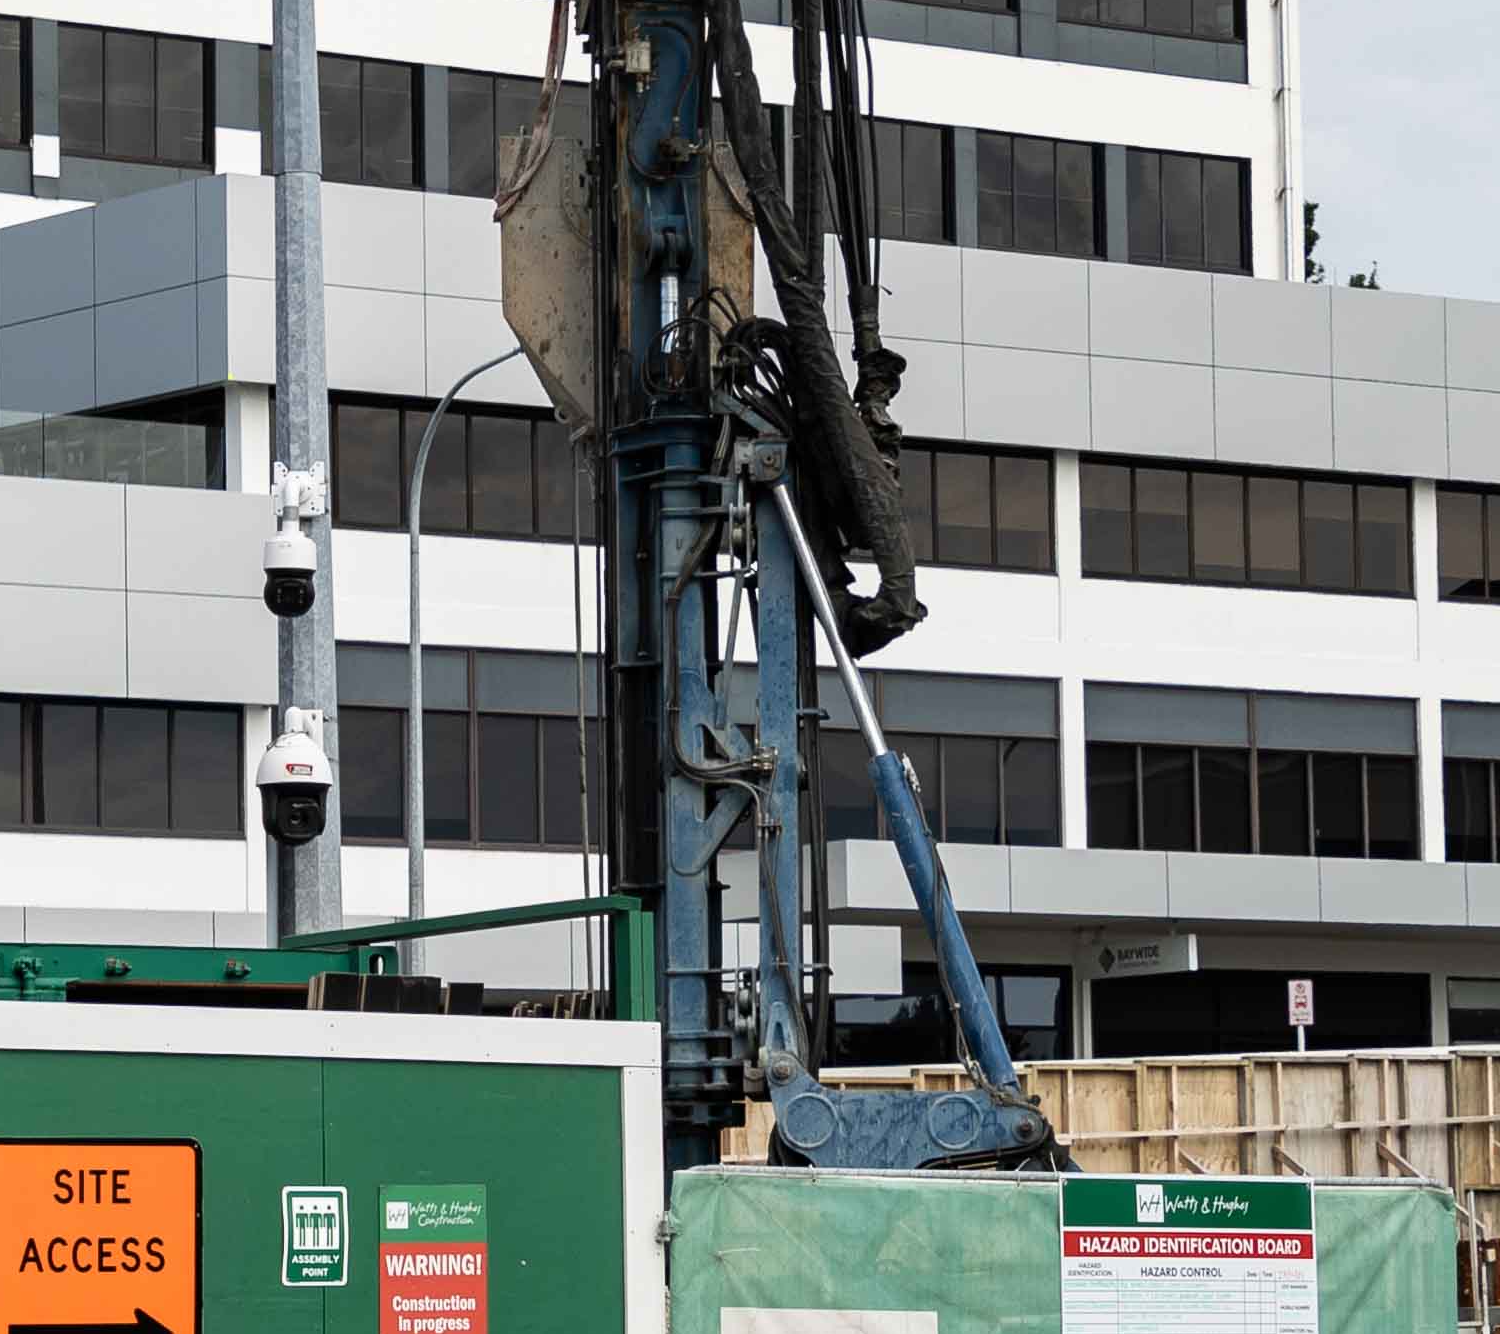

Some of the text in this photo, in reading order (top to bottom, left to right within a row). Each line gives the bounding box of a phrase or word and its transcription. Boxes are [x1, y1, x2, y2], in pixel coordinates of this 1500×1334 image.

[53, 1169, 131, 1205] SITE
[409, 1201, 481, 1216] Watts & Hughes
[1139, 1195, 1161, 1213] WH
[1164, 1195, 1249, 1217] Watts & Hughes
[417, 1214, 474, 1228] Construction
[1079, 1236, 1301, 1255] HAZARD IDENTIFICATION BOARD
[19, 1237, 166, 1274] ACCESS
[292, 1254, 340, 1264] ASSEMBLY
[385, 1253, 482, 1276] WARNING!
[302, 1268, 328, 1277] POINT
[1140, 1267, 1223, 1278] HAZARD CONTROL
[392, 1295, 476, 1311] Construction
[414, 1316, 470, 1334] progress
